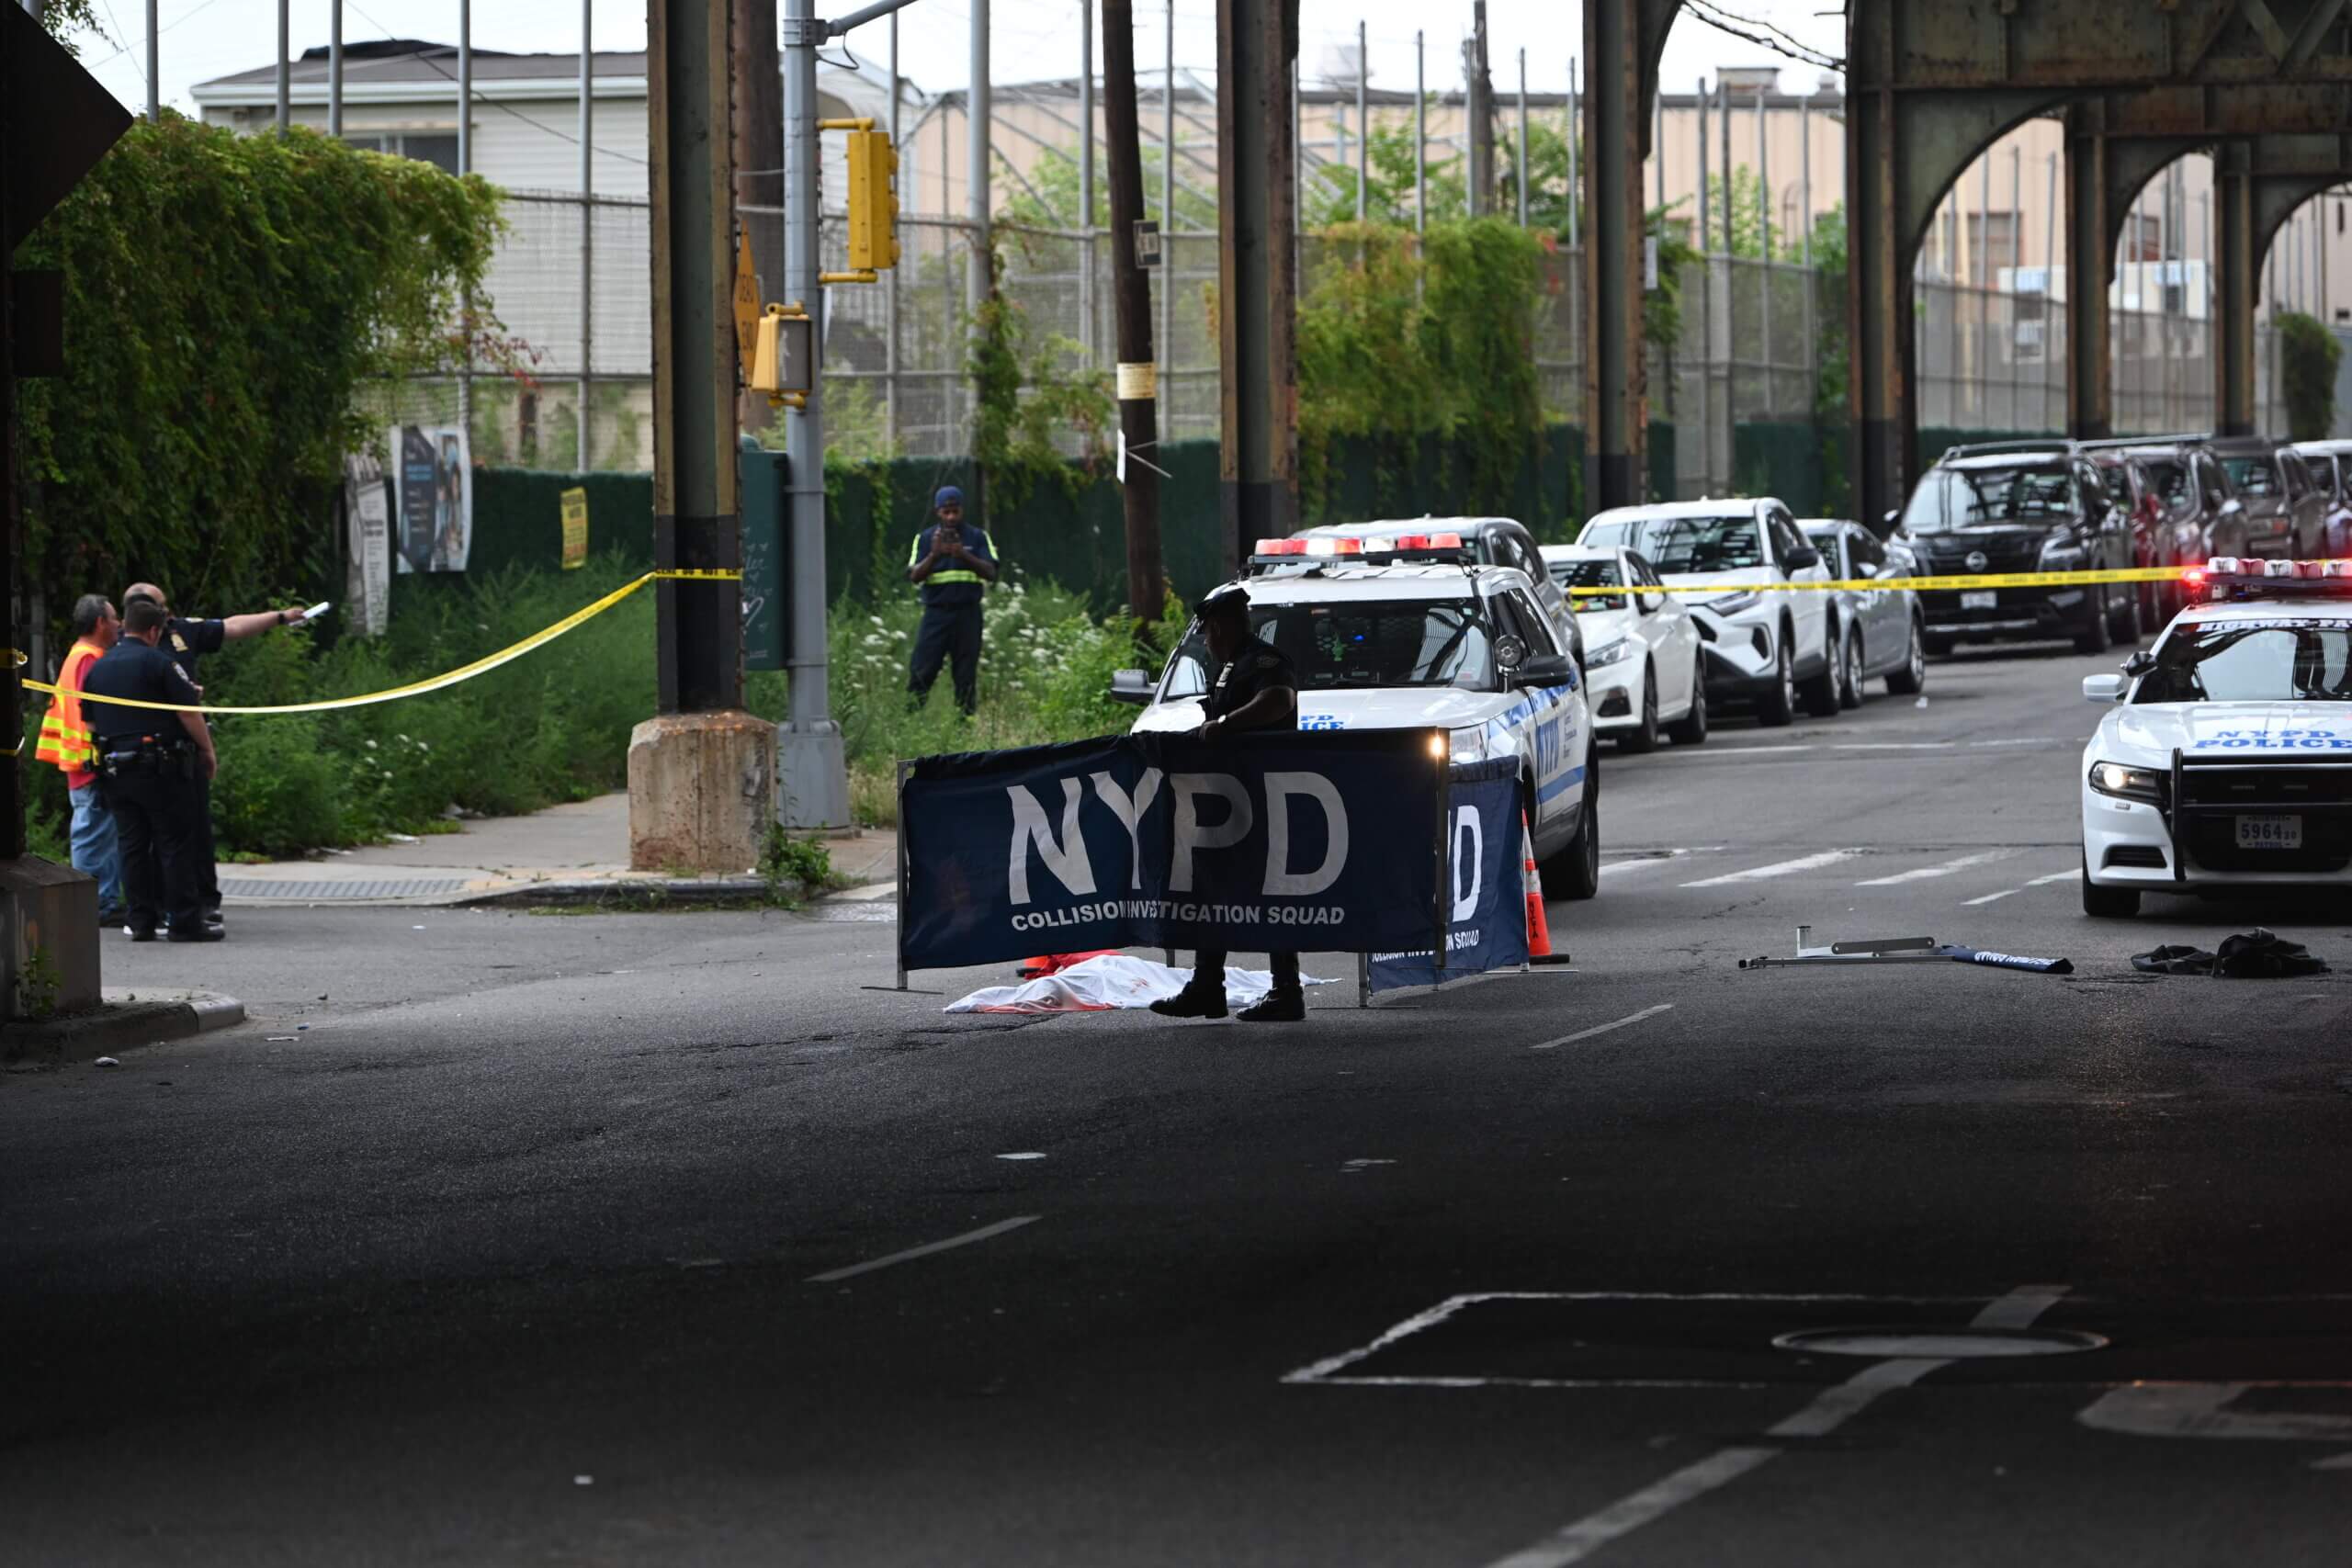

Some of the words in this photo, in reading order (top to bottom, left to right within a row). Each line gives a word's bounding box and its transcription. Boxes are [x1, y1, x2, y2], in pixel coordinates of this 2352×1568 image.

[2193, 739, 2352, 749] POLICE
[1006, 767, 1349, 905] NYPD
[2241, 823, 2281, 840] 5964
[1267, 906, 1344, 926] SQUAD
